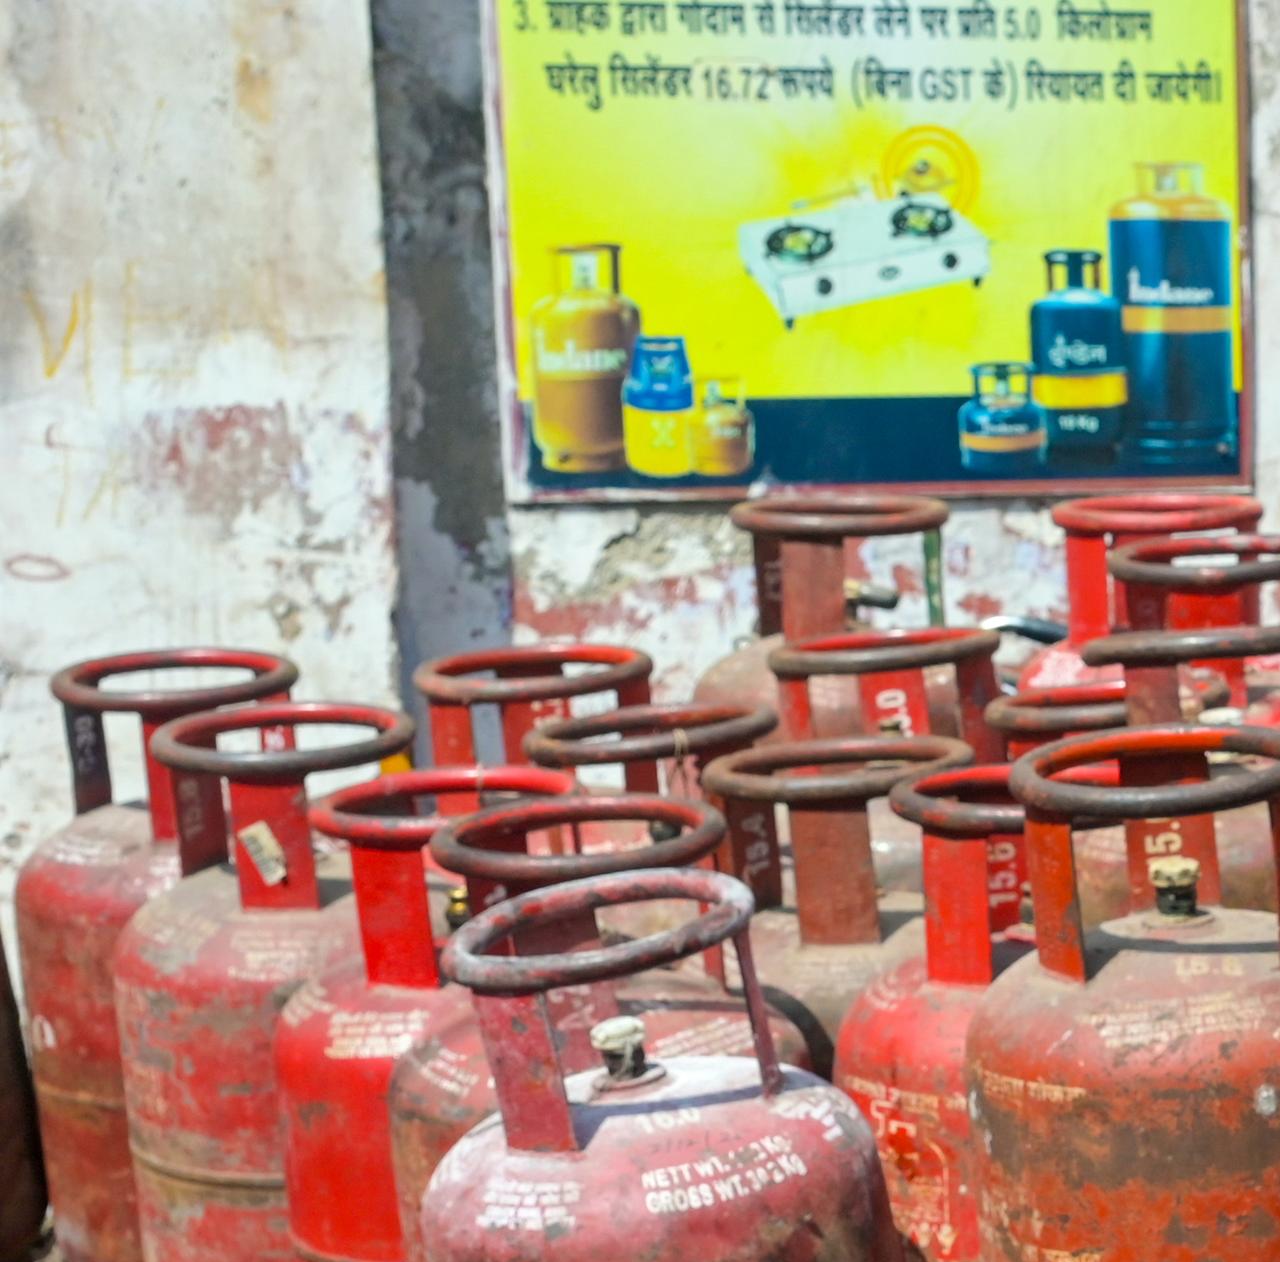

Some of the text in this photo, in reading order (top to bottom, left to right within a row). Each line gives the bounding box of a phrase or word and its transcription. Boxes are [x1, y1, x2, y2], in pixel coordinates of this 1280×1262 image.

[920, 8, 949, 39] पर
[1003, 7, 1041, 40] 5.0
[703, 66, 772, 101] 16.72
[919, 67, 974, 102] GST
[1112, 59, 1137, 102] दी
[640, 1154, 732, 1191] NETT WT.
[644, 1182, 715, 1215] GROSS
[717, 1174, 750, 1202] WT.
